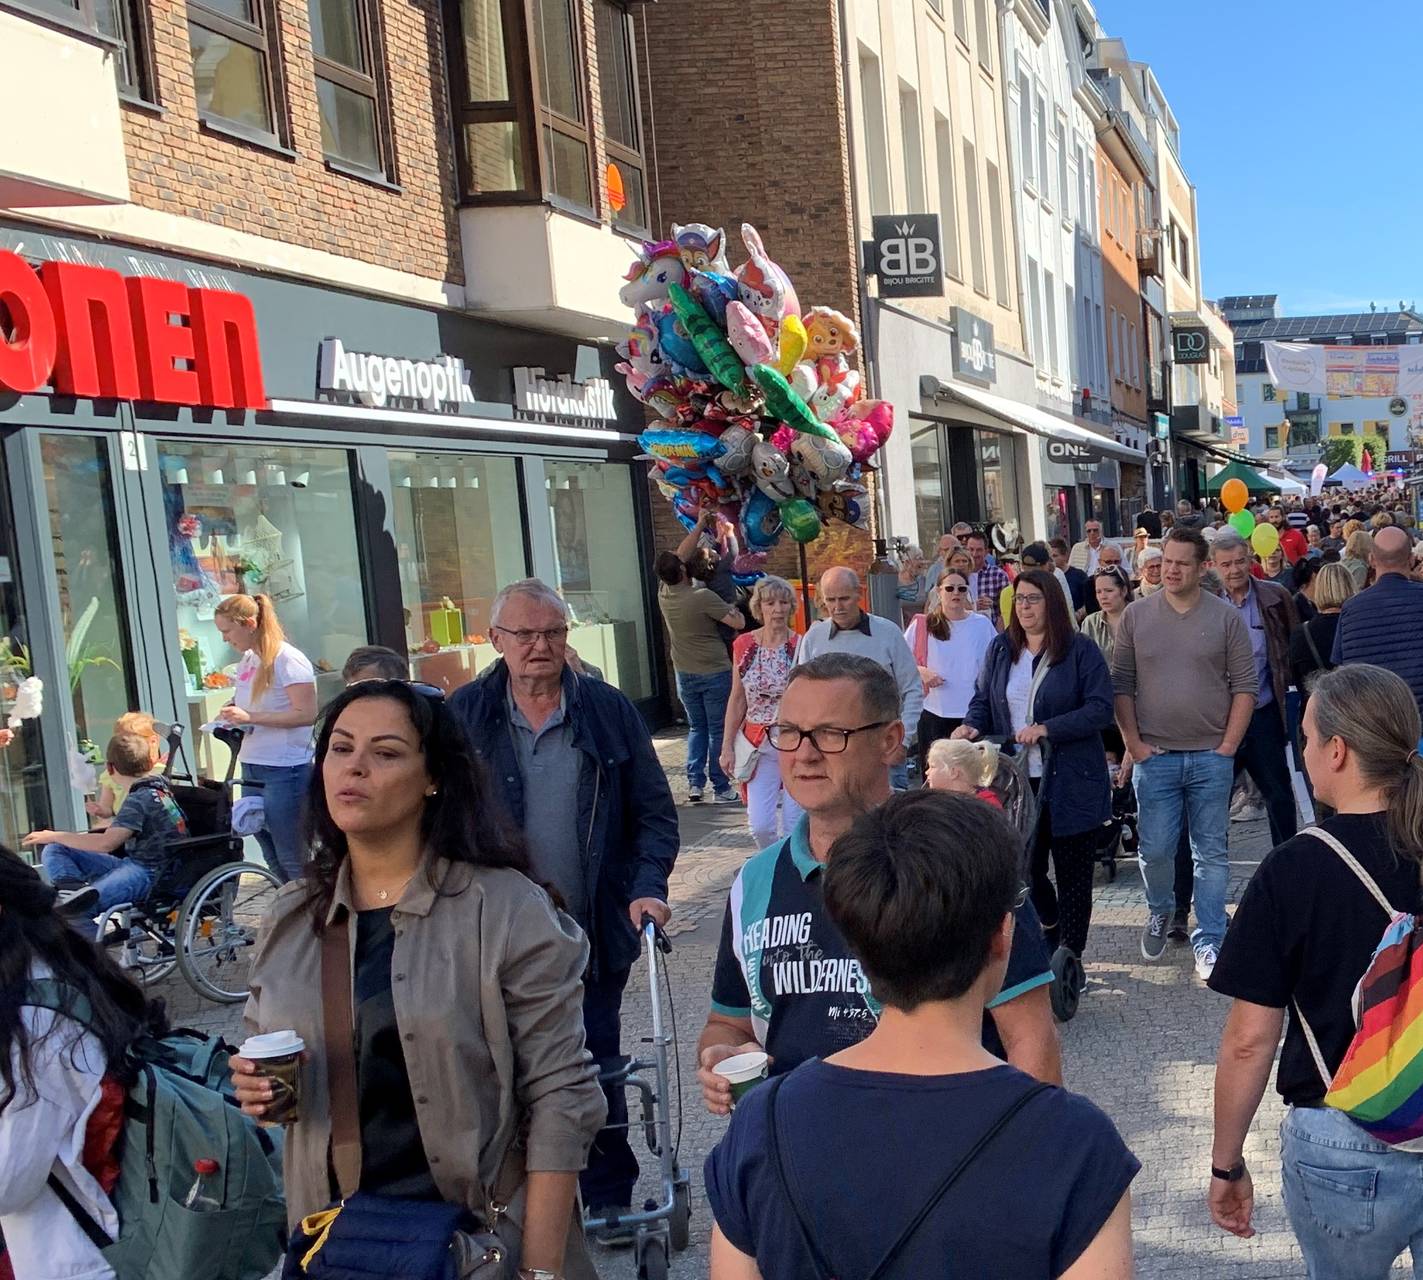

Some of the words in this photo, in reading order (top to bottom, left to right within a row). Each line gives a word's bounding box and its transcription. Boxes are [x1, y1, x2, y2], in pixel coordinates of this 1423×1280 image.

[883, 277, 903, 287] BIJOU
[905, 276, 935, 285] BRIGITTE
[322, 337, 475, 410] Augenoptik
[744, 912, 813, 955] HEADING
[795, 939, 825, 961] the
[773, 958, 872, 996] WILDERNES
